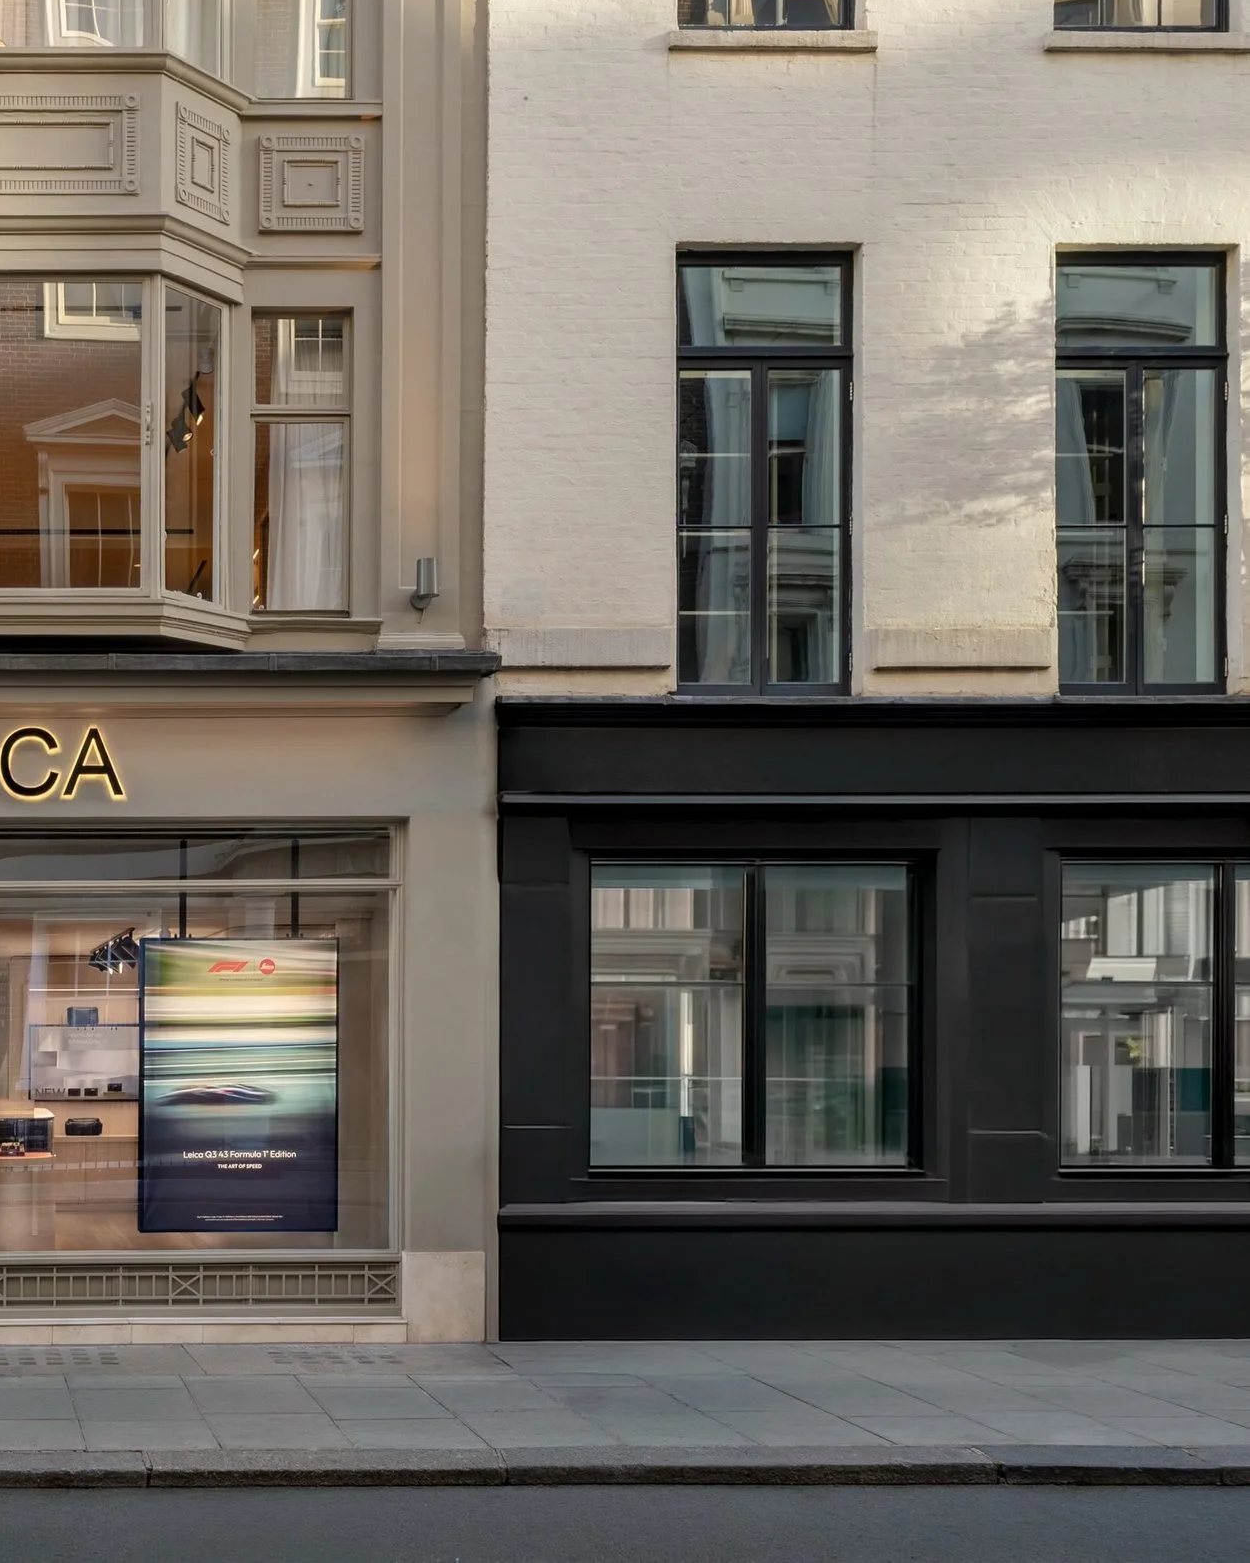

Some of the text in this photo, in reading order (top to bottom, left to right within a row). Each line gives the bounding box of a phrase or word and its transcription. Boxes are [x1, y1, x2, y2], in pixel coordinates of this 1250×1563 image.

[34, 1088, 66, 1097] NEW
[183, 1150, 204, 1159] Leica
[204, 1150, 217, 1159] Q3
[218, 1150, 229, 1158] 43
[230, 1150, 262, 1158] Formula
[270, 1150, 297, 1158] Edition
